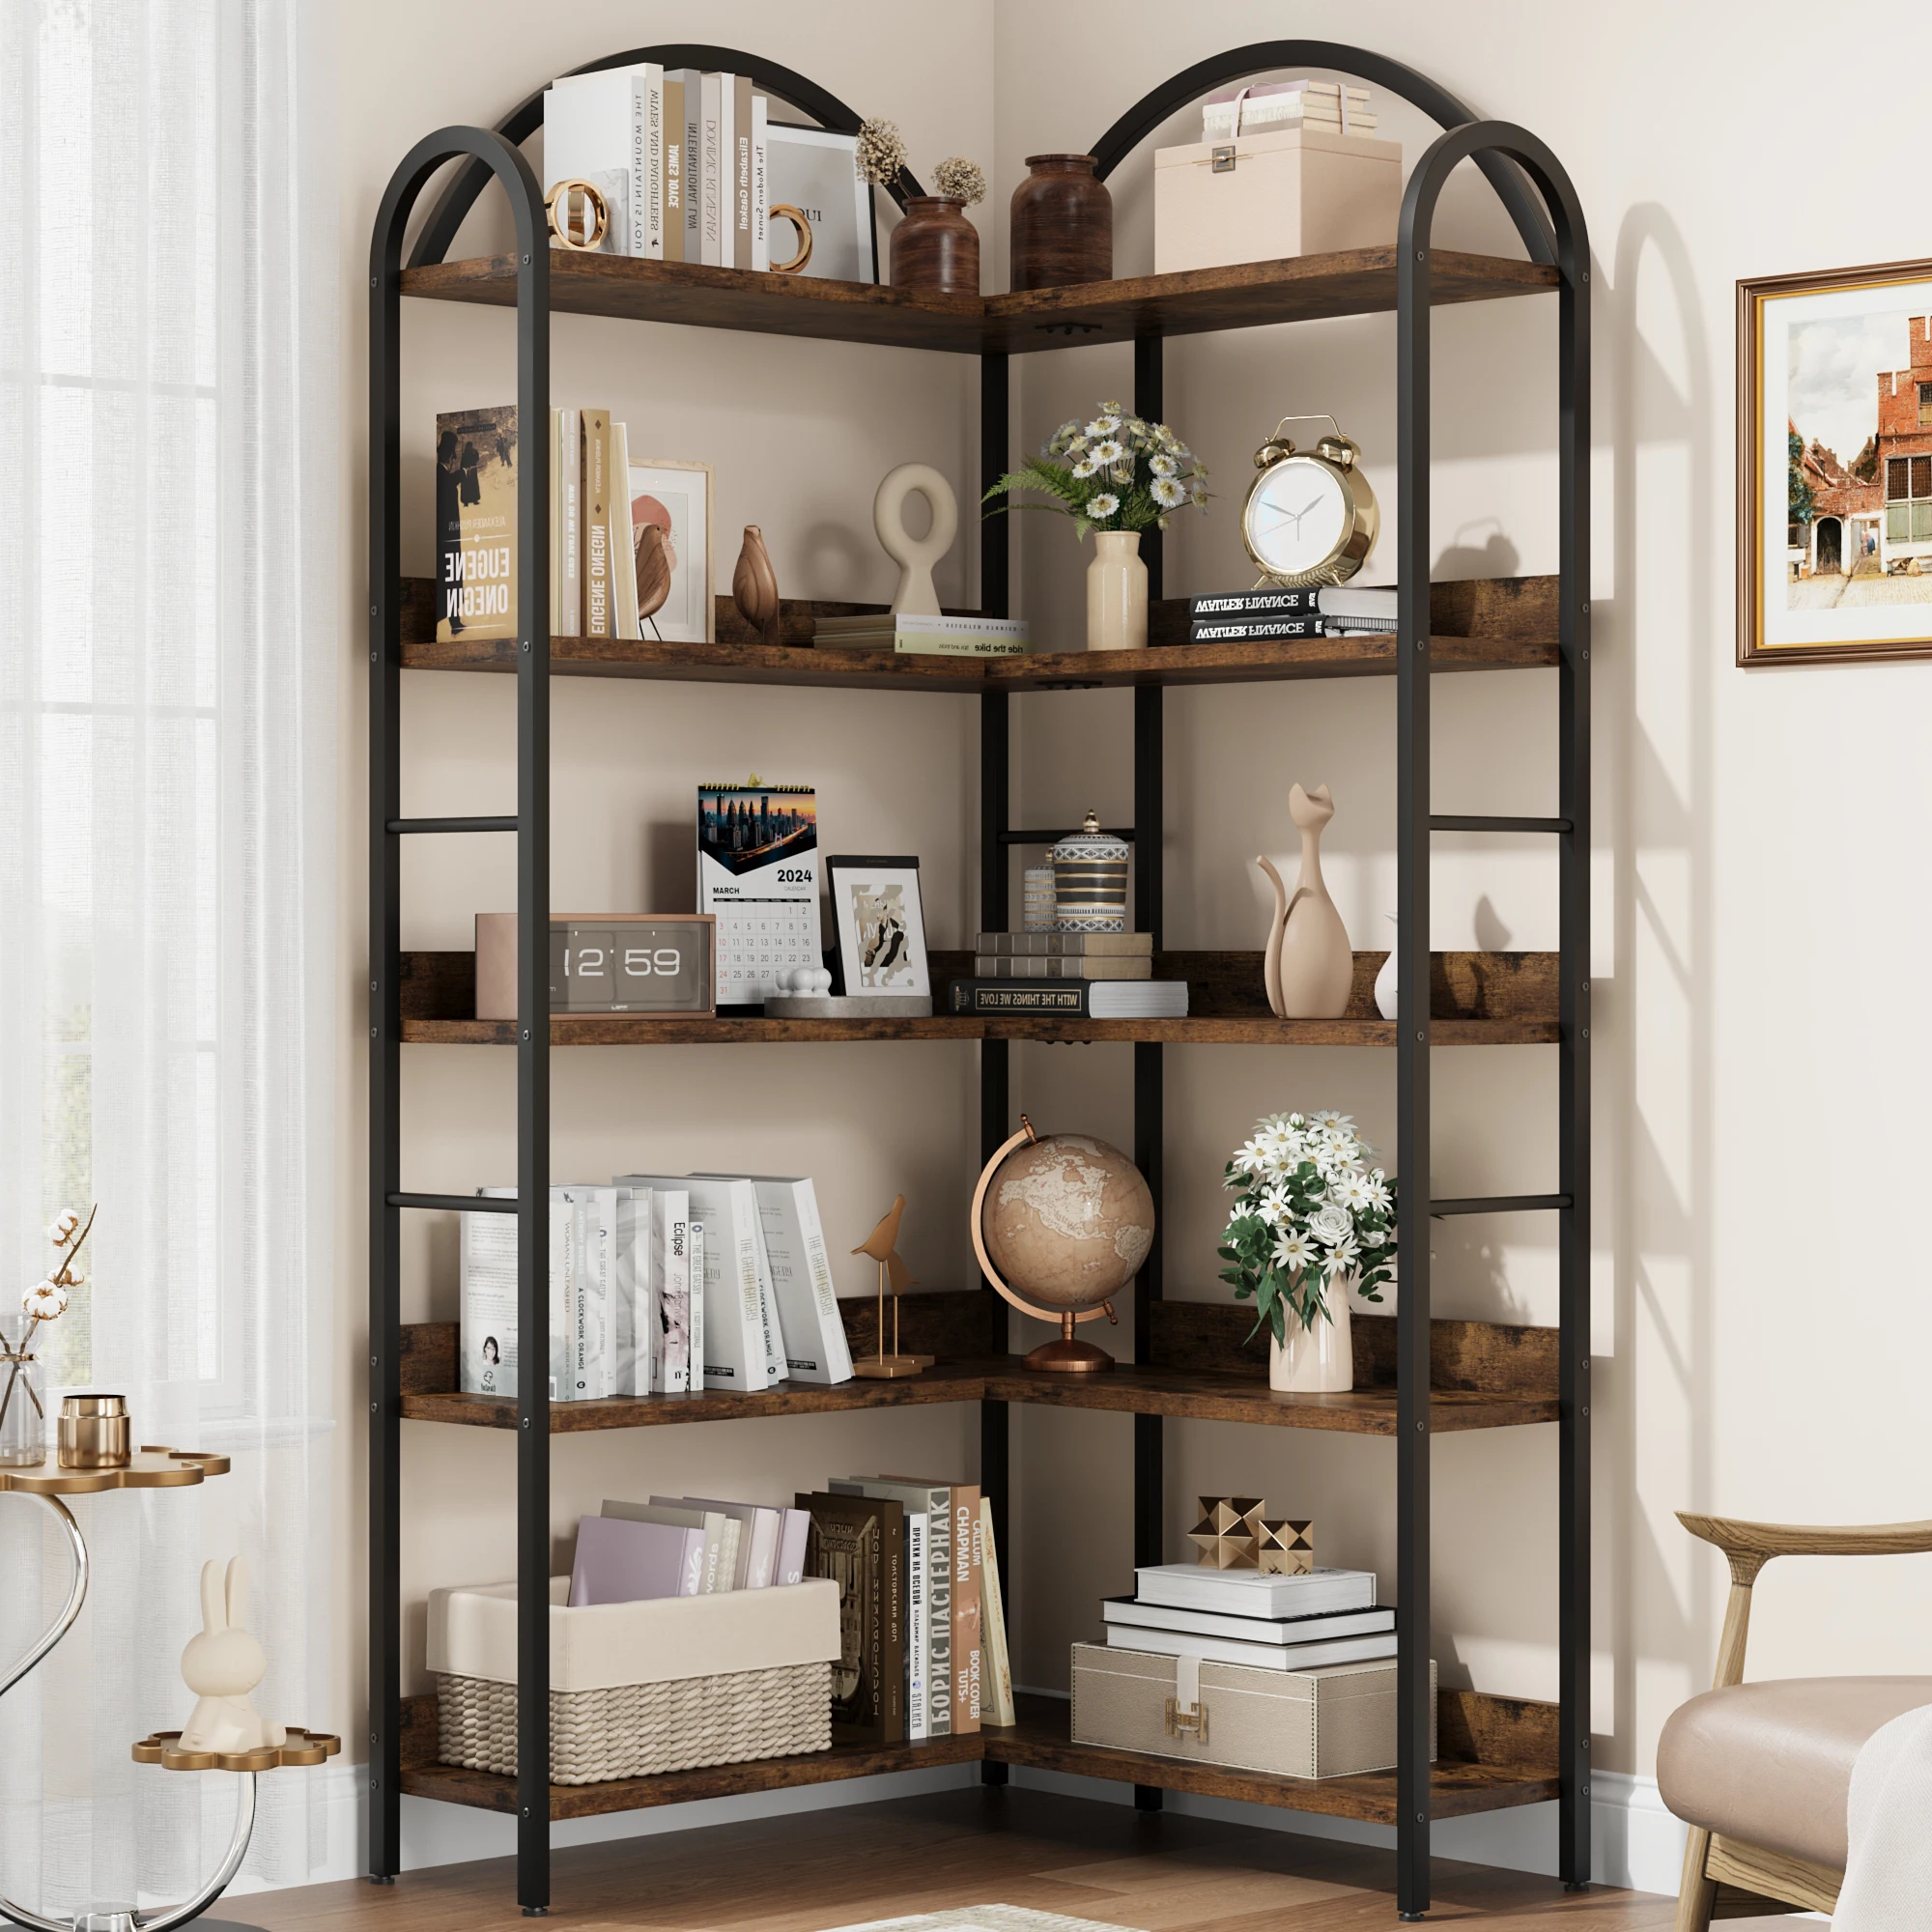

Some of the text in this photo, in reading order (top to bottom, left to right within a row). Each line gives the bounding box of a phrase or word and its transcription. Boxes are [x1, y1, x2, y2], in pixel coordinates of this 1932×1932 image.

[797, 208, 822, 222] UI
[777, 869, 812, 883] 2024
[719, 970, 770, 979] 24 25 26 27
[670, 1222, 685, 1257] Eclipse
[740, 1238, 753, 1256] THE
[808, 1236, 822, 1251] THE
[692, 1244, 702, 1295] THE GREAT GATSBY
[742, 1257, 756, 1284] GREAT
[811, 1253, 828, 1282] GREAT
[744, 1287, 758, 1321] GATSBY
[816, 1283, 834, 1317] GATSBY
[764, 1329, 773, 1357] ORANGE
[956, 1506, 970, 1582] CHAPMAN
[972, 1520, 980, 1567] CALLUM
[912, 1527, 922, 1605] ПРЯТКИ НА ОСЕВОЙ
[930, 1492, 951, 1723] БОРИС ПАСТЕРНАК
[958, 1668, 968, 1703] TUTS+
[970, 1649, 980, 1719] BOOK COVER
